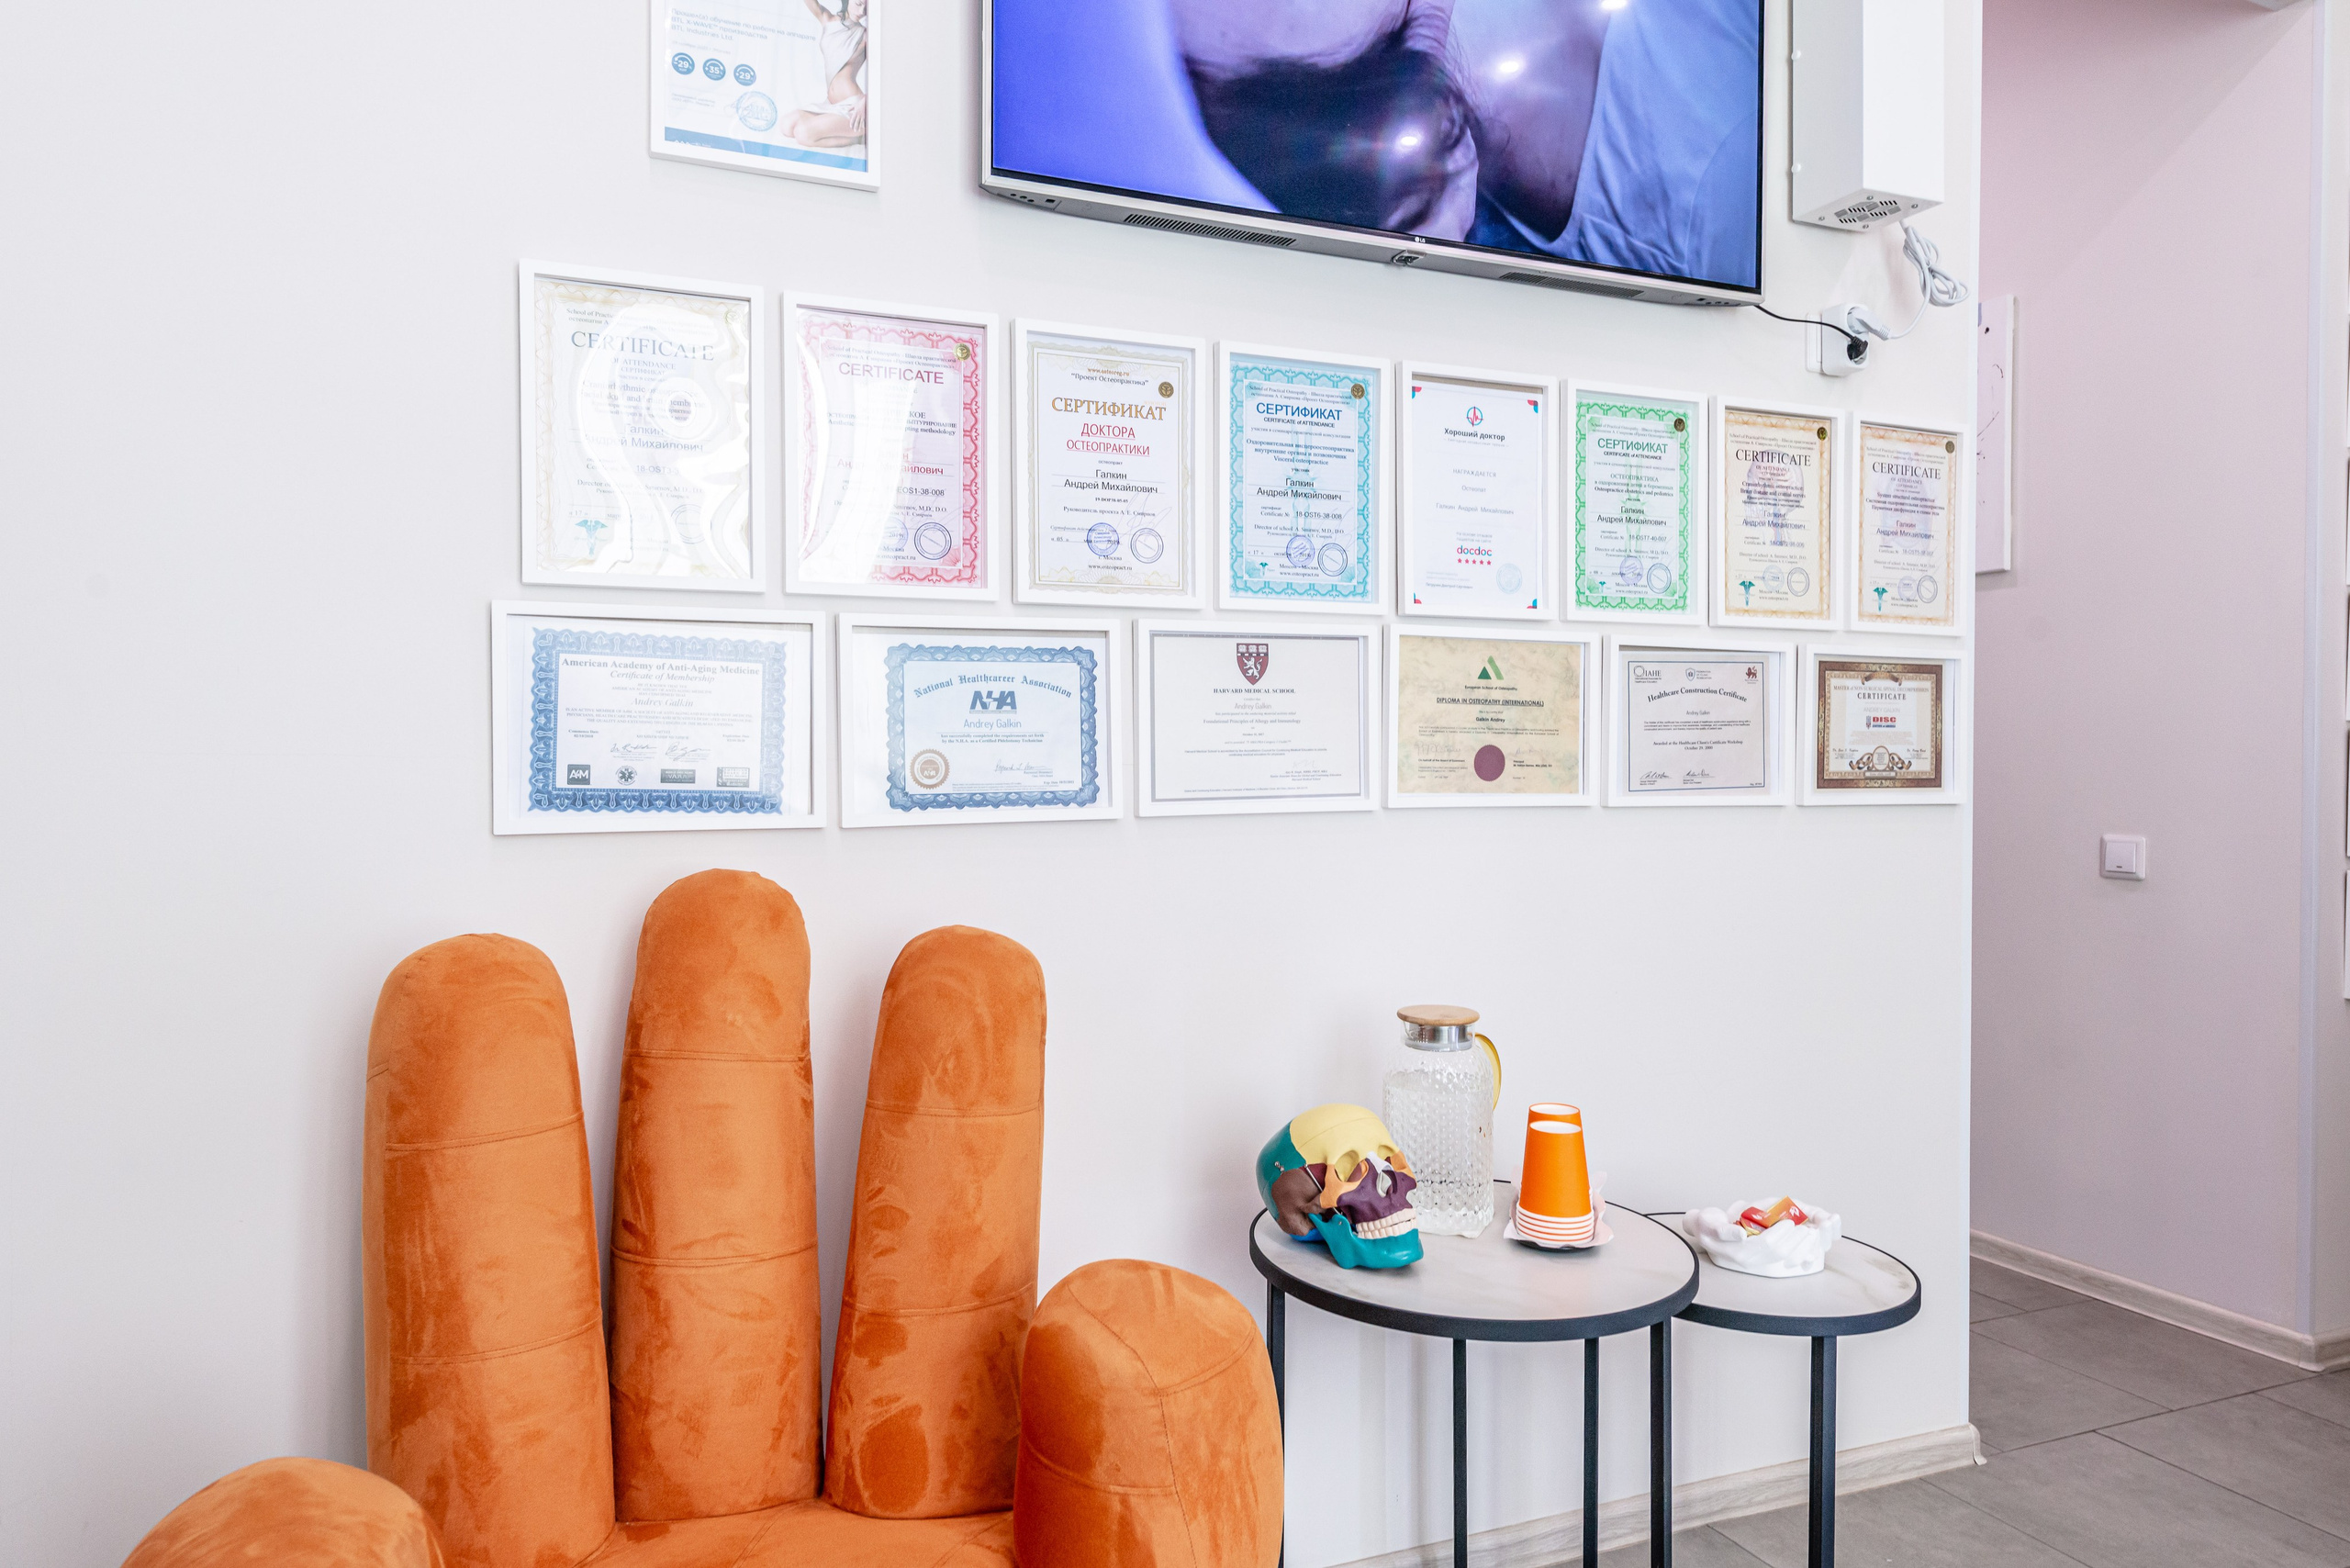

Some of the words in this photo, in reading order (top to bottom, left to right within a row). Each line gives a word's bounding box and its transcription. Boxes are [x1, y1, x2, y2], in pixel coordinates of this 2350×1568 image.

[671, 8, 709, 20] Прошел(а)
[710, 17, 742, 28] обучение
[753, 25, 776, 34] работе
[786, 31, 816, 41] аппарате
[687, 27, 720, 38] Industries
[720, 27, 767, 39] производства
[566, 308, 586, 317] School
[571, 330, 714, 362] CERTIFICATE
[622, 358, 676, 370] ATTENDANCE
[839, 362, 944, 385] CERTIFICATE
[1052, 397, 1166, 420] СЕРТИФИКАТ
[1257, 402, 1343, 420] СЕРТИФИКАТ
[920, 427, 957, 435] methodology
[1081, 423, 1136, 439] ДОКТОРА
[1444, 428, 1478, 437] Хороший
[1479, 431, 1505, 442] доктор
[632, 437, 703, 452] Михайлович
[1067, 439, 1150, 455] ОСТЕОПРАКТИКИ
[1247, 439, 1293, 448] Оздоровительная
[1597, 438, 1668, 454] СЕРТИФИКАТ
[1295, 457, 1329, 465] osteopractice
[1736, 449, 1811, 466] CERTIFICATE
[1096, 470, 1127, 479] Галкин
[1452, 468, 1496, 477] НАГРАЖДАЕТСЯ
[1873, 462, 1941, 480] CERTIFICATE
[1285, 477, 1315, 487] Галкин
[1610, 473, 1659, 482] ОСТЕОПРАКТИКА
[1064, 479, 1099, 490] Андрей
[1102, 481, 1158, 493] Михайлович
[1257, 487, 1289, 498] Андрей
[1291, 490, 1342, 500] Михайлович
[1620, 506, 1644, 514] Галкин
[1597, 514, 1623, 523] Андрей
[1626, 516, 1667, 526] Михайлович
[1742, 519, 1765, 527] Андрей
[1768, 521, 1806, 530] Михайлович
[1876, 528, 1898, 536] Андрей
[1900, 530, 1934, 540] Михайлович
[1457, 544, 1493, 556] docdoc
[562, 658, 608, 667] American
[610, 661, 654, 671] Academy
[667, 664, 717, 674] Anti-Aging
[720, 666, 760, 675] Medicine
[610, 670, 654, 680] Certificate
[655, 673, 665, 681] of
[666, 673, 715, 684] Membership
[913, 678, 953, 699] National
[958, 674, 1015, 684] Healthcareer
[1021, 676, 1072, 699] Association
[969, 690, 1017, 710] NHA
[1648, 689, 1679, 702] Healthcare
[1718, 689, 1747, 702] Certificate
[1857, 692, 1907, 700] CERTIFICATE
[632, 698, 662, 707] Andrey
[666, 699, 693, 707] Galkin
[1235, 702, 1254, 711] Andrey
[964, 719, 994, 731] Andrey
[996, 719, 1022, 729] Galkin
